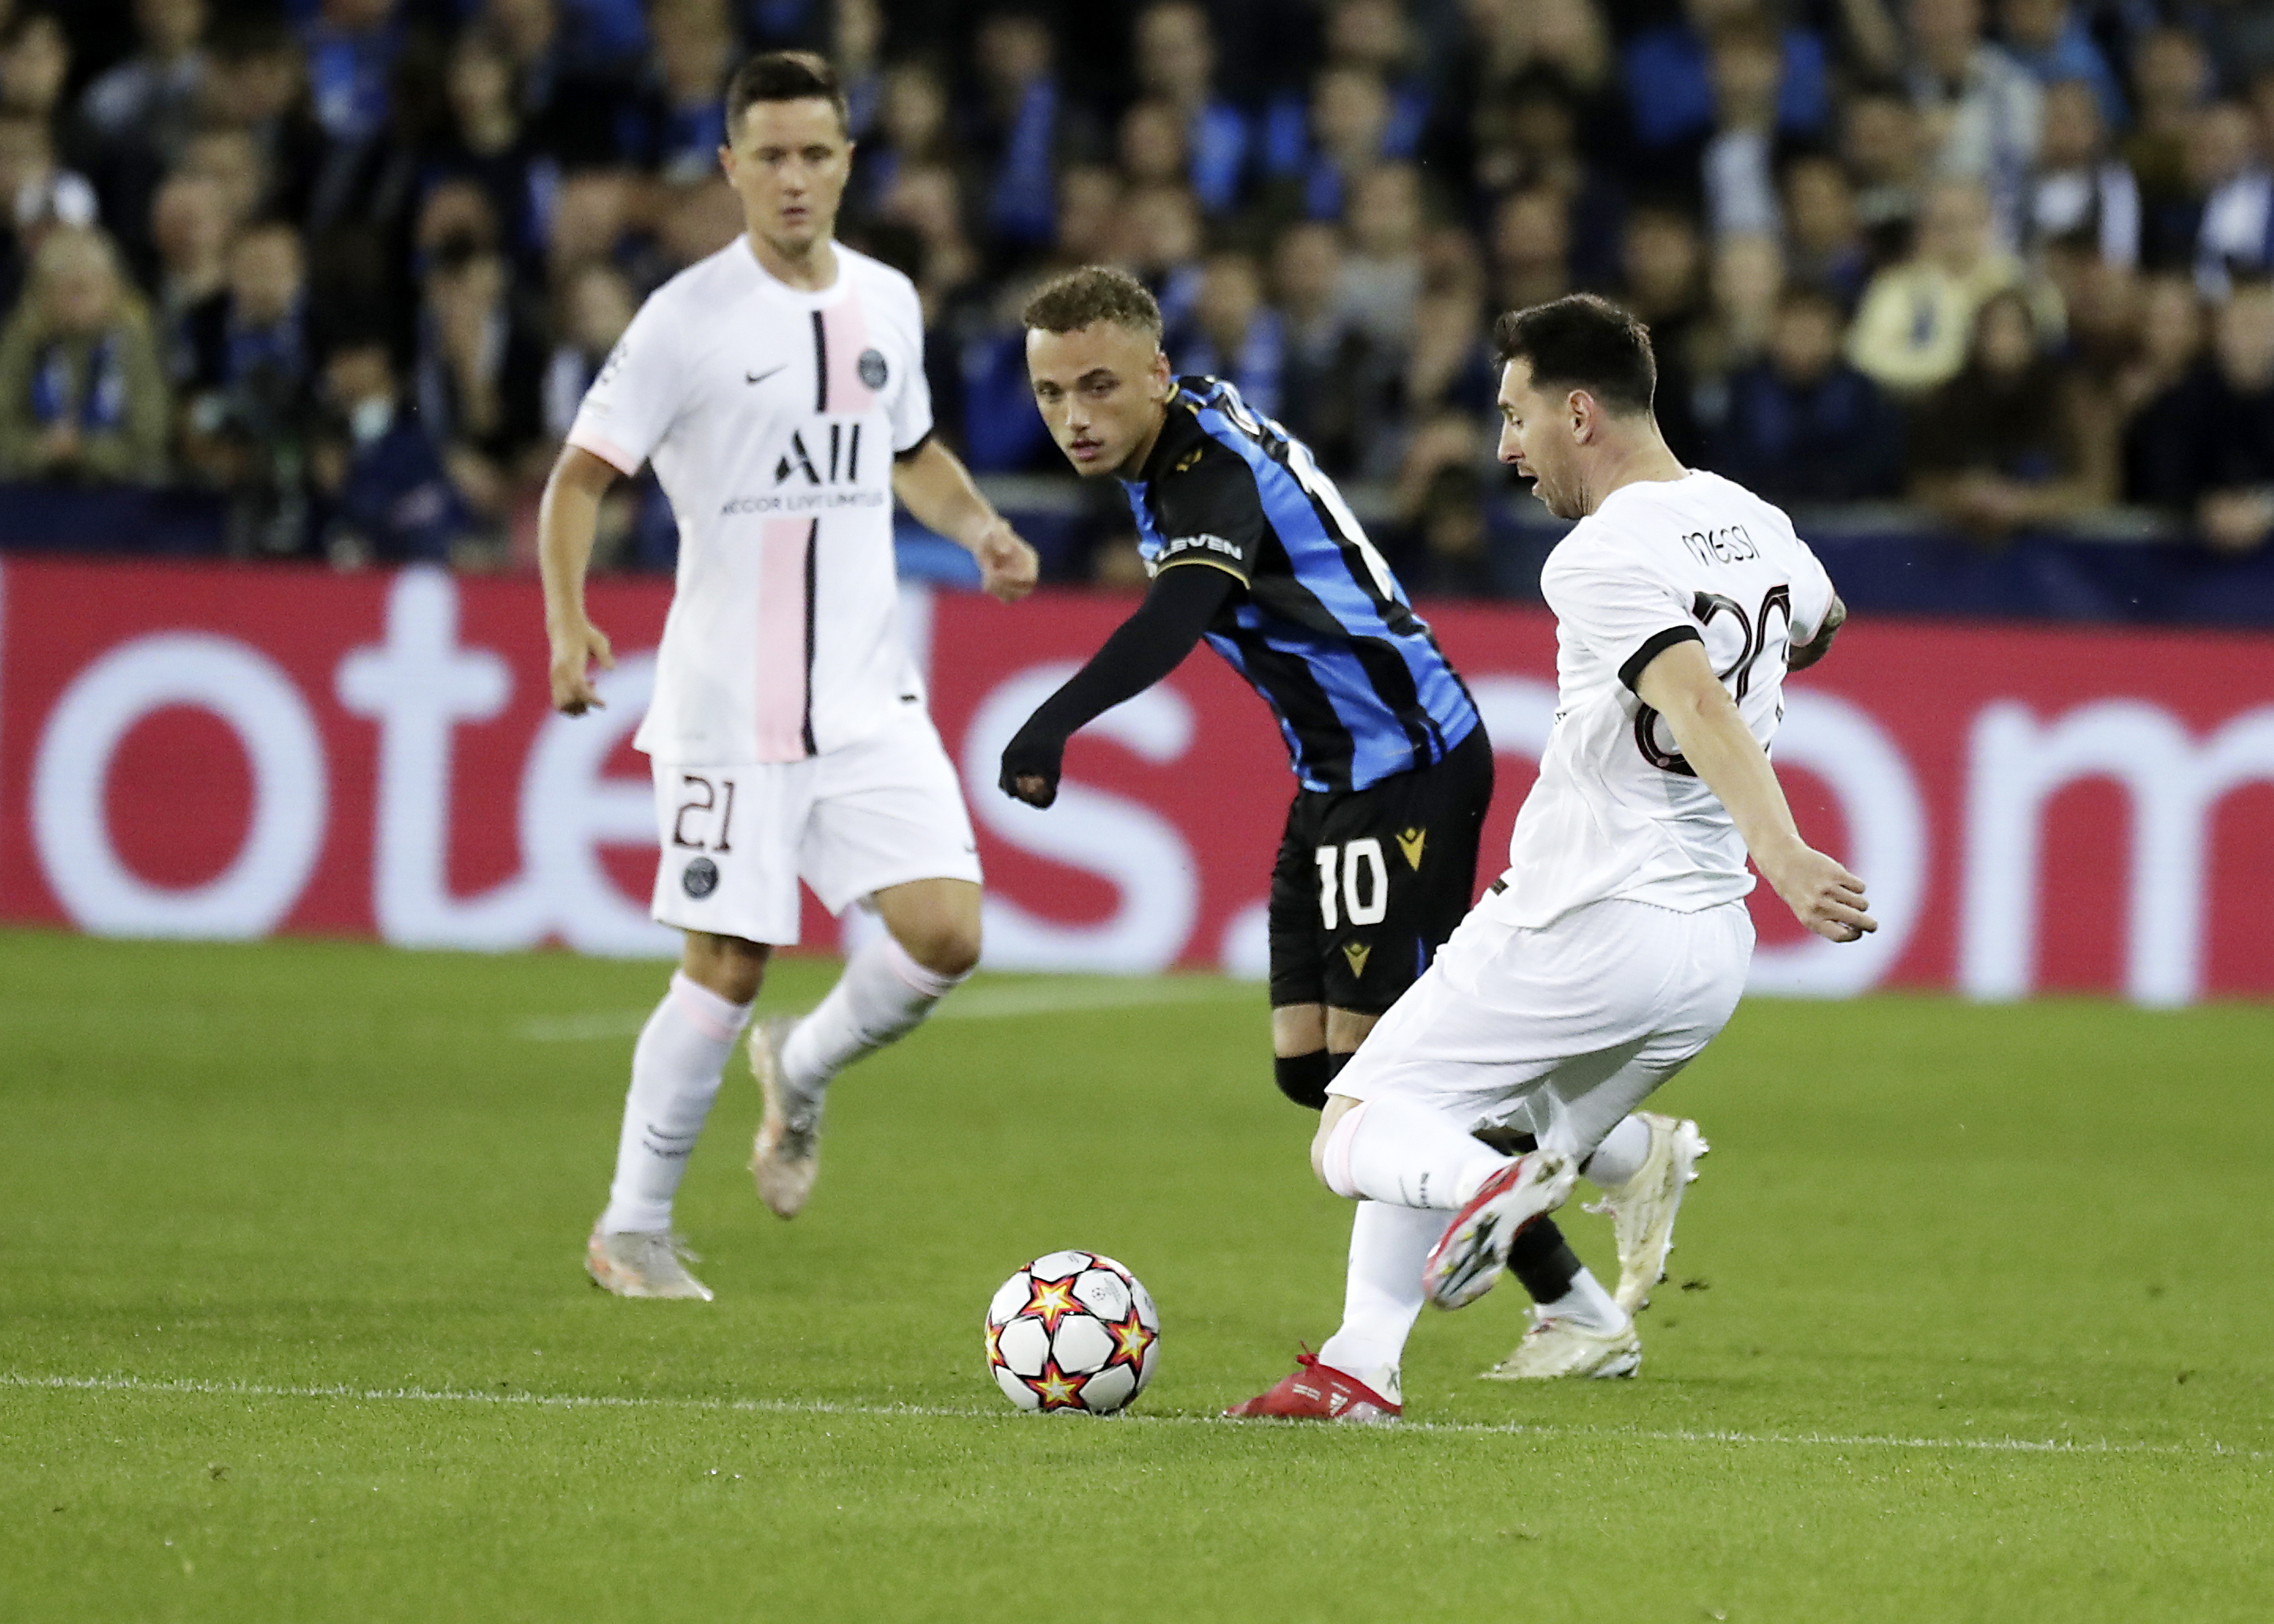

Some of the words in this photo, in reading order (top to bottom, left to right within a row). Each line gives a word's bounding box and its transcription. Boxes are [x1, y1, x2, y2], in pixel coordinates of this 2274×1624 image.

[1681, 524, 1760, 567] MESSI
[673, 773, 735, 853] 21
[1315, 837, 1389, 930] 10
